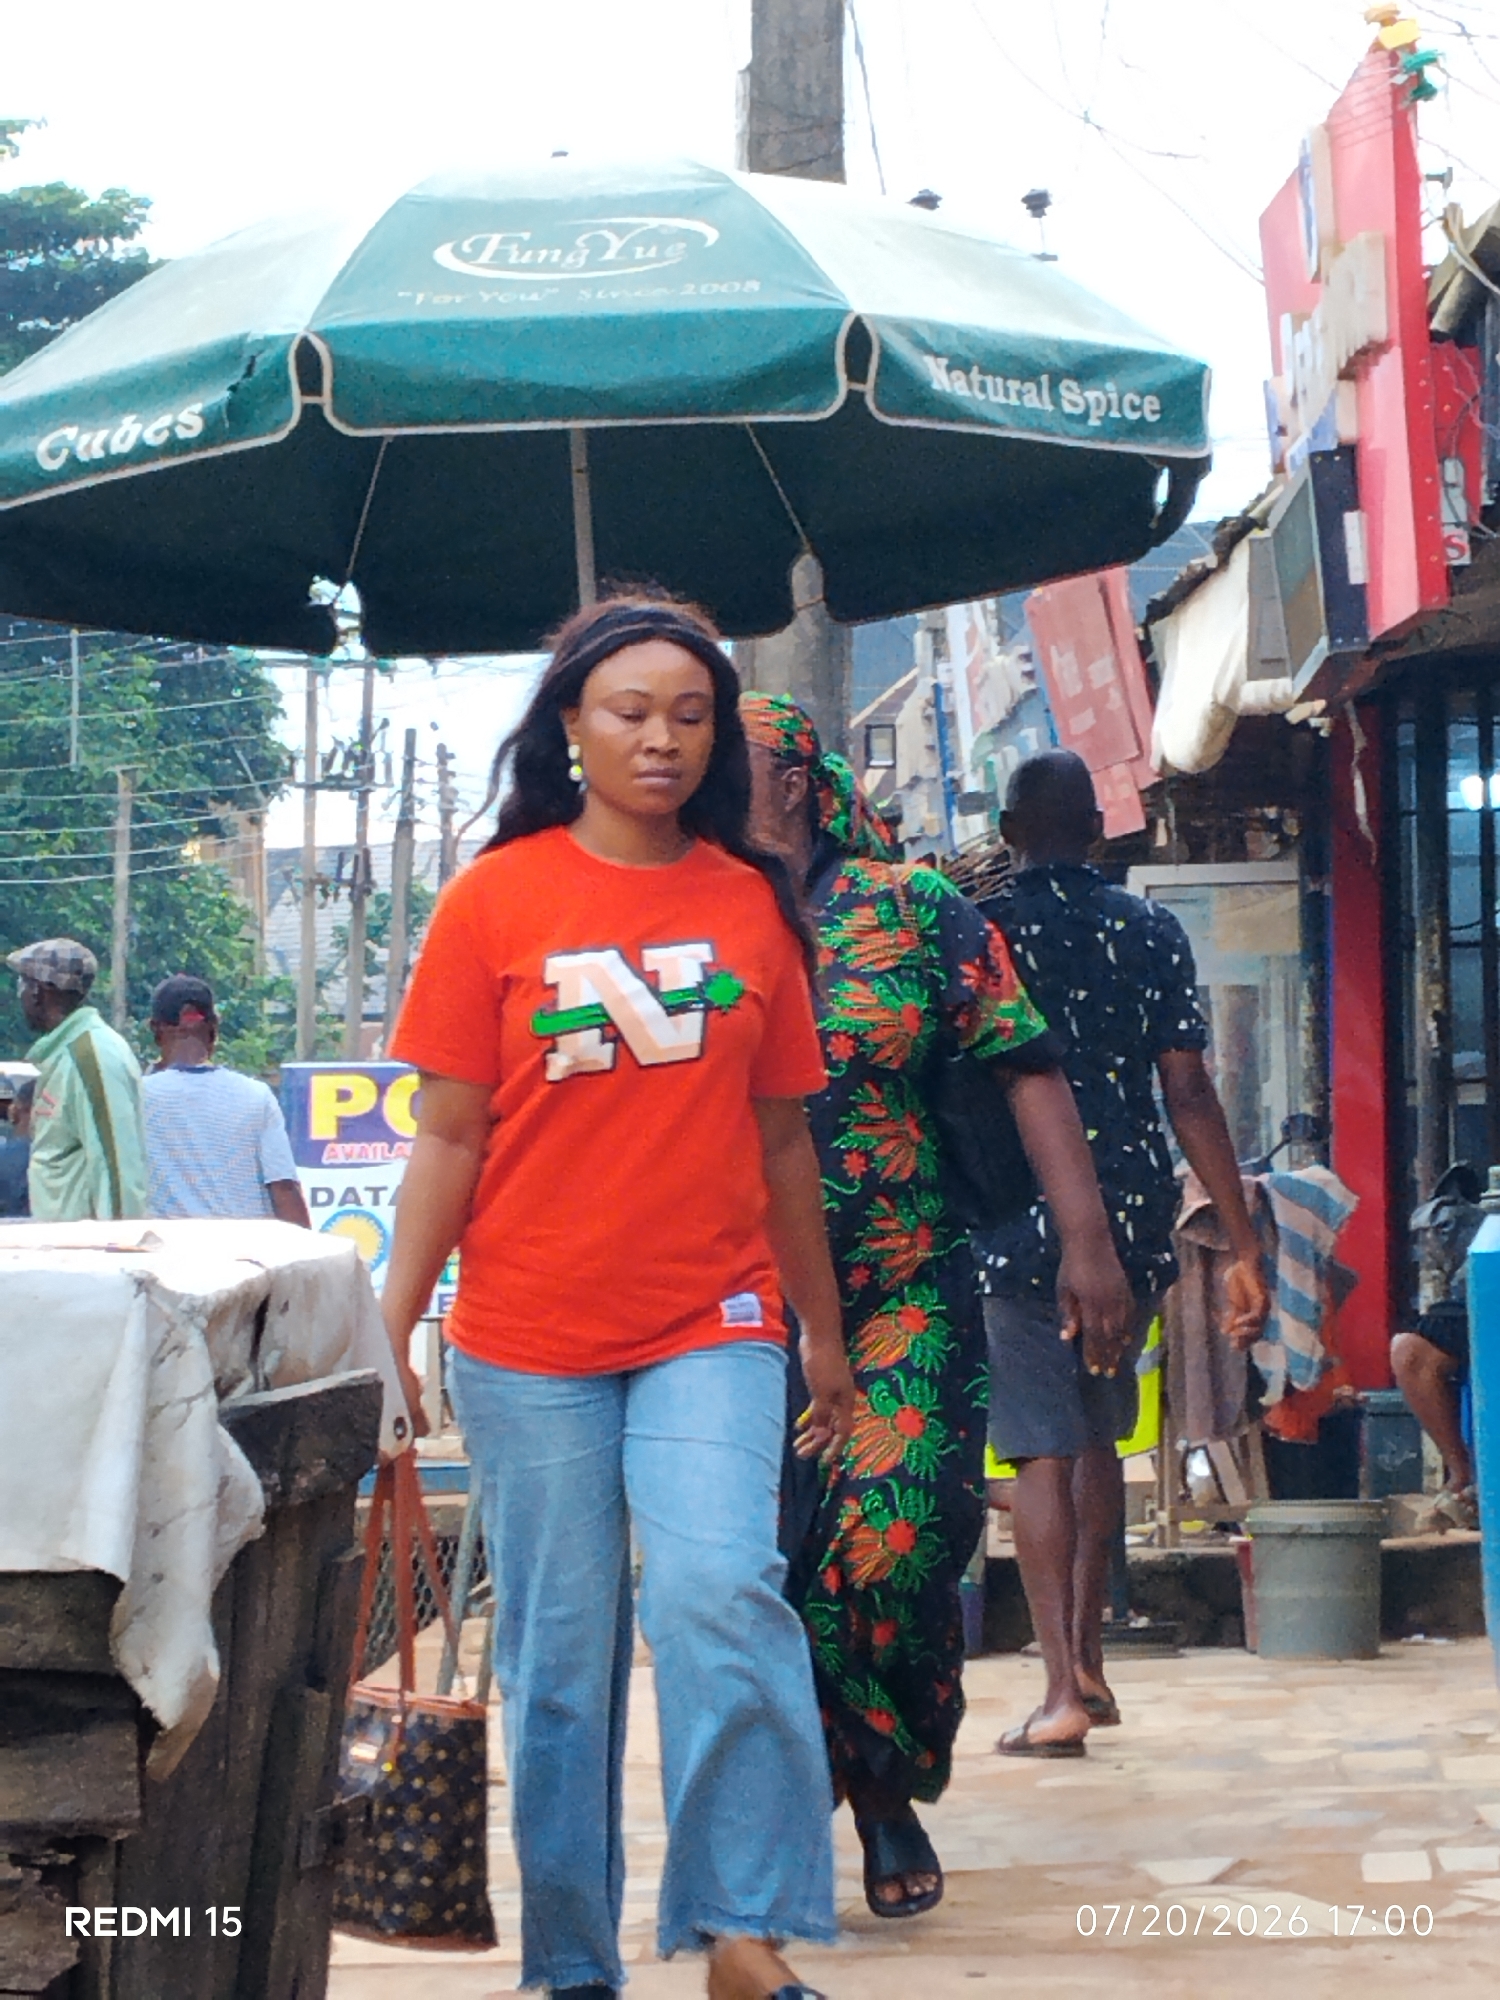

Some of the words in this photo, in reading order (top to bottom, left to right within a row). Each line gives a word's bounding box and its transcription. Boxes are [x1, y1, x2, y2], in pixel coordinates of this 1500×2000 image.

[461, 231, 590, 270] Fung
[575, 225, 688, 261] Yue
[680, 279, 761, 296] 2008
[923, 355, 1055, 412] Natural
[1059, 378, 1162, 426] Spice
[35, 402, 204, 470] Cubes
